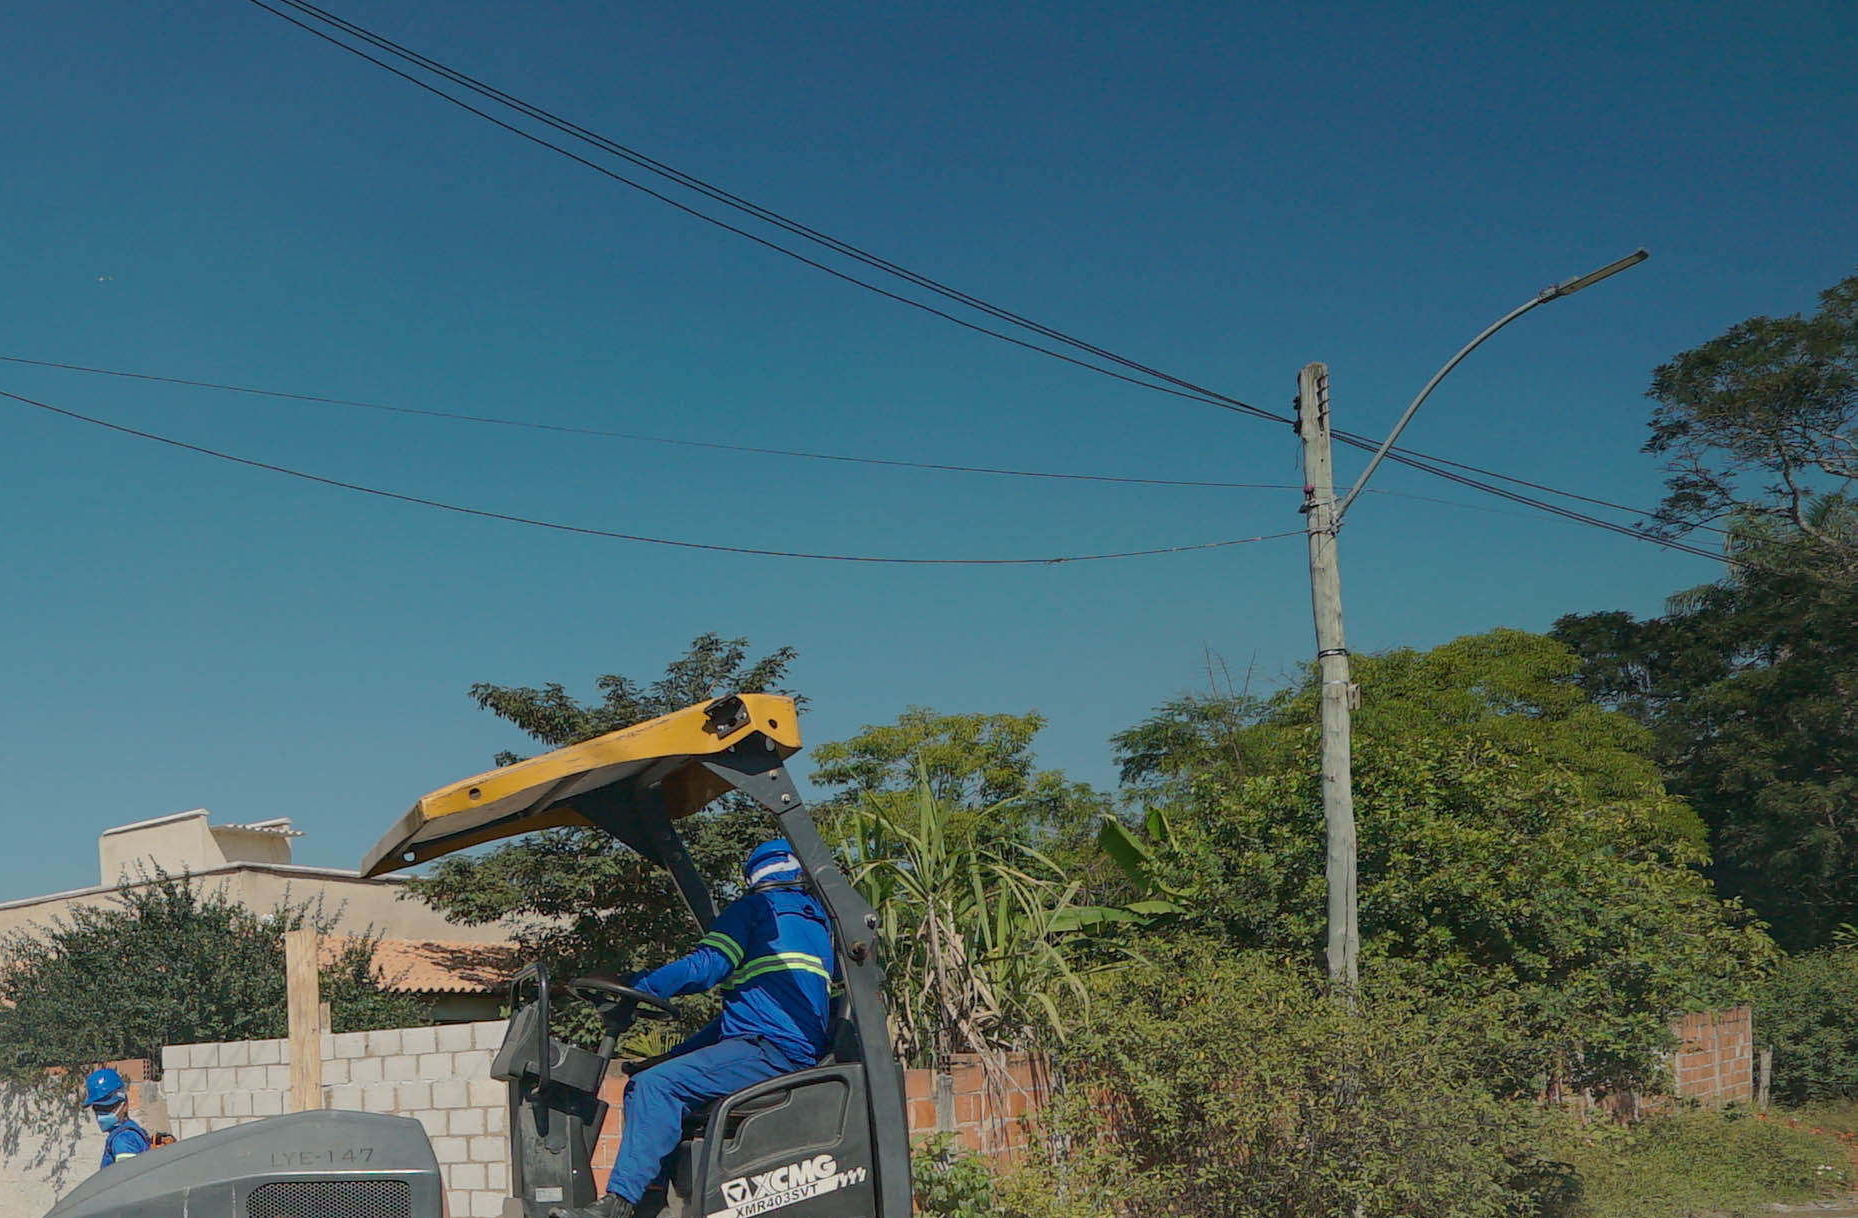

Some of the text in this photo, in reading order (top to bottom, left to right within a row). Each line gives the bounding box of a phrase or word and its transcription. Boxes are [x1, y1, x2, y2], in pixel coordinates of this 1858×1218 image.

[269, 1147, 374, 1168] LYE-147
[750, 1154, 838, 1200] XCMG
[734, 1183, 820, 1218] XMR403SVT
